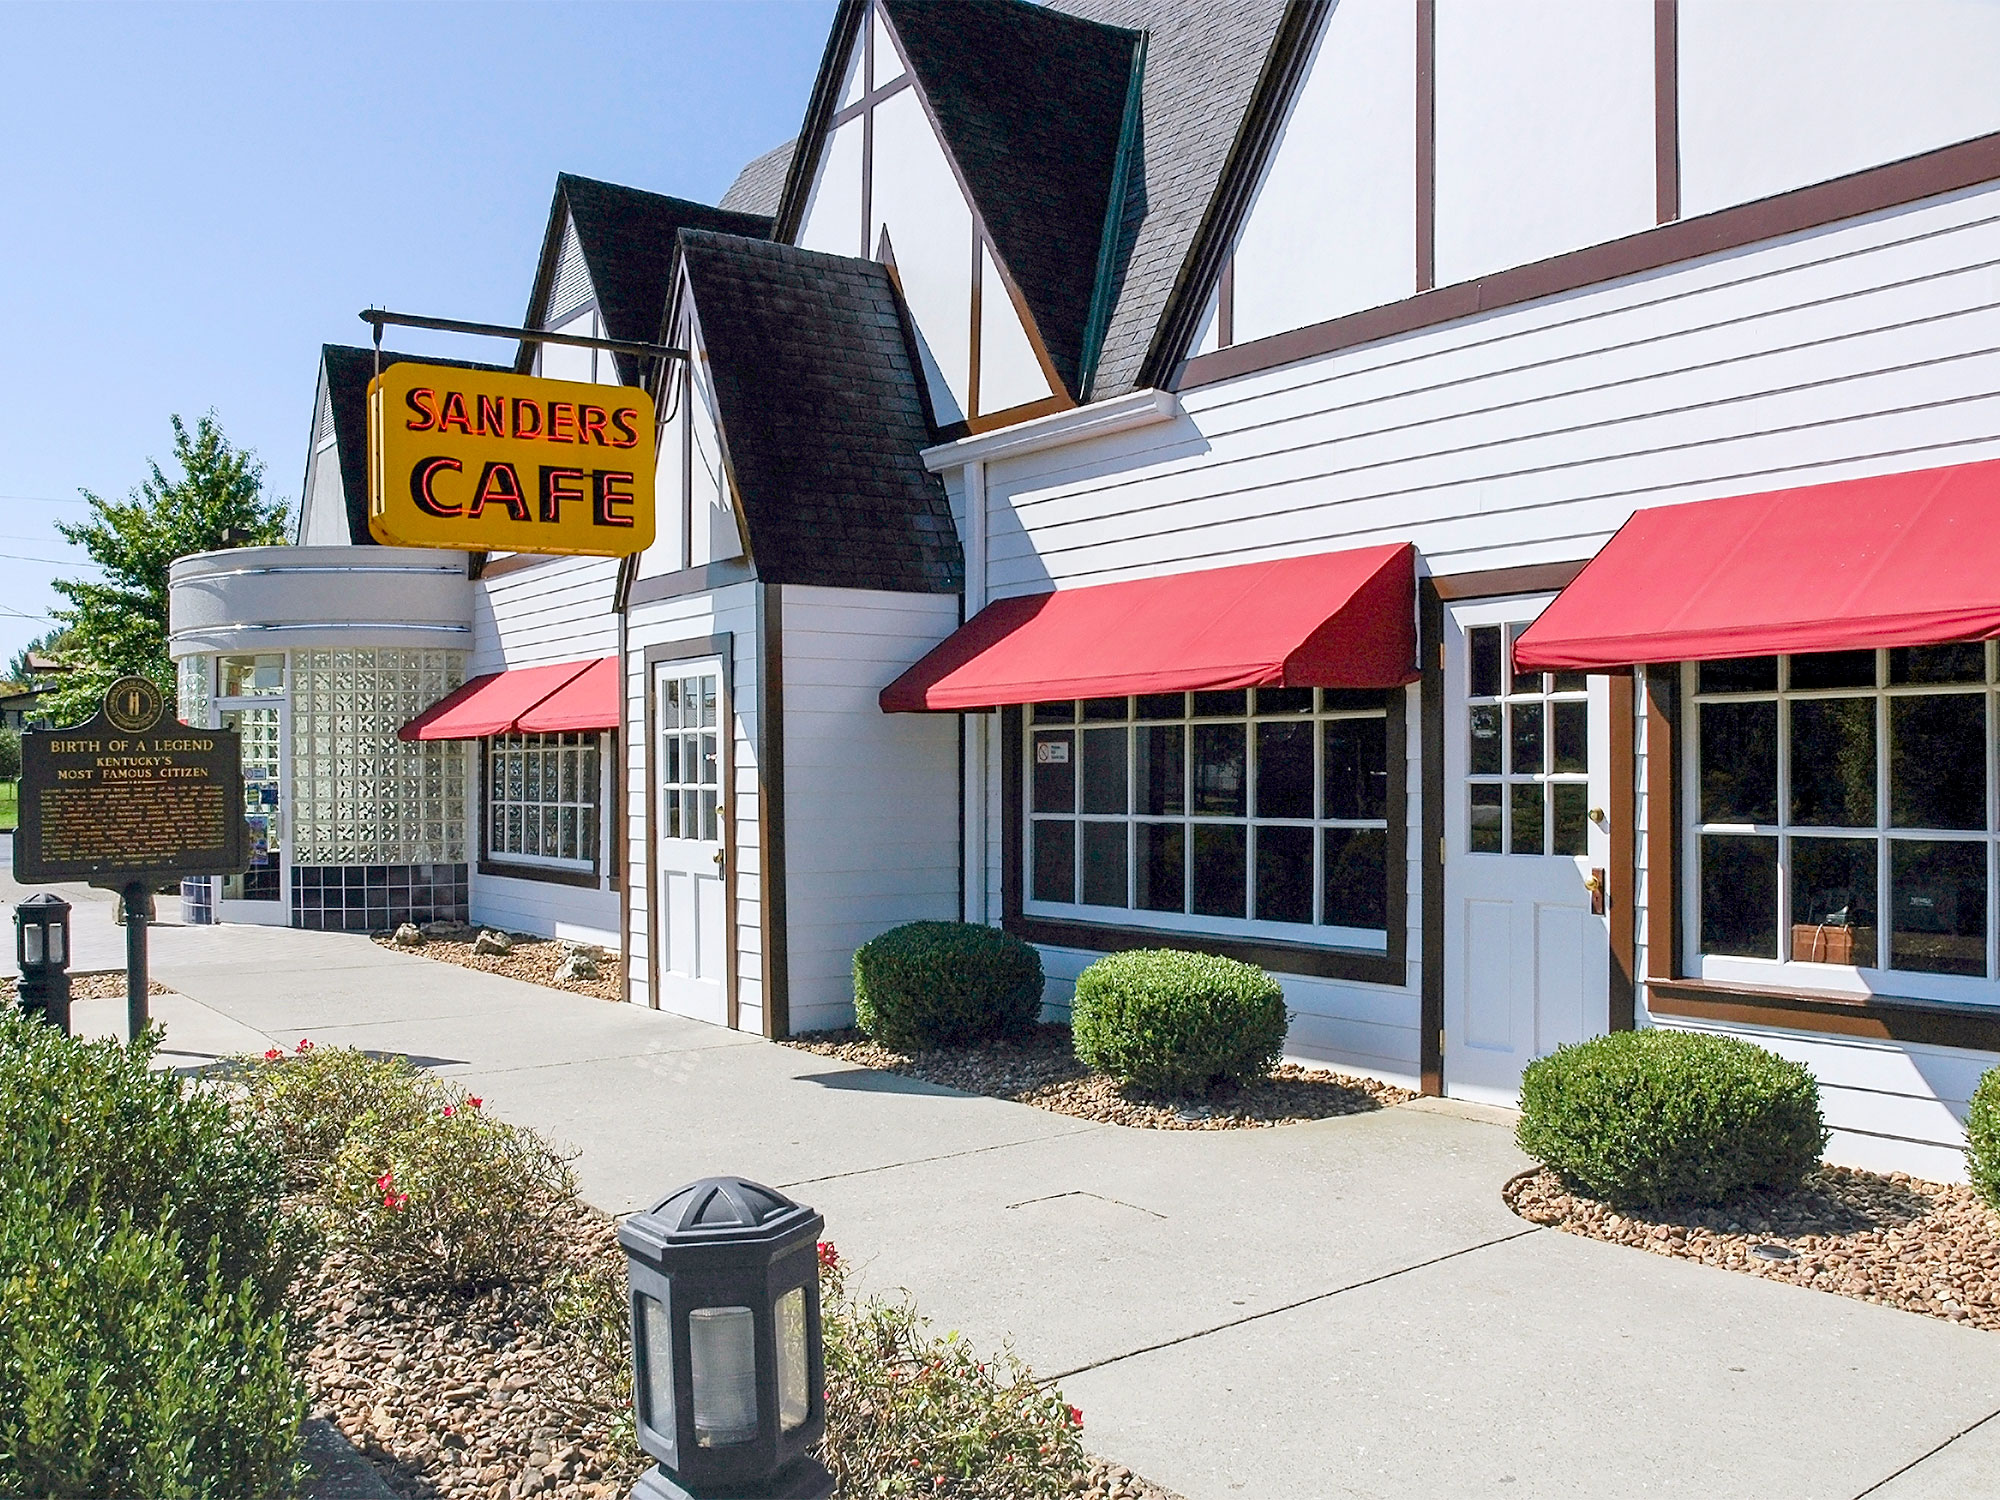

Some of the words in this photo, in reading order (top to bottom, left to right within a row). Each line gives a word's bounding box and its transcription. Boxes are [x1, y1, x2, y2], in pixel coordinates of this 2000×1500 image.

[406, 387, 639, 449] SANDERS
[409, 456, 635, 528] CAFE
[51, 741, 99, 752] BIRTH
[108, 740, 128, 751] OF
[135, 740, 146, 751] A
[154, 739, 214, 751] LEGEND
[96, 756, 172, 767] KENTUCKY'S
[57, 769, 94, 780] MOST
[102, 768, 151, 779] FAMOUS
[160, 767, 209, 778] CITIZEN
